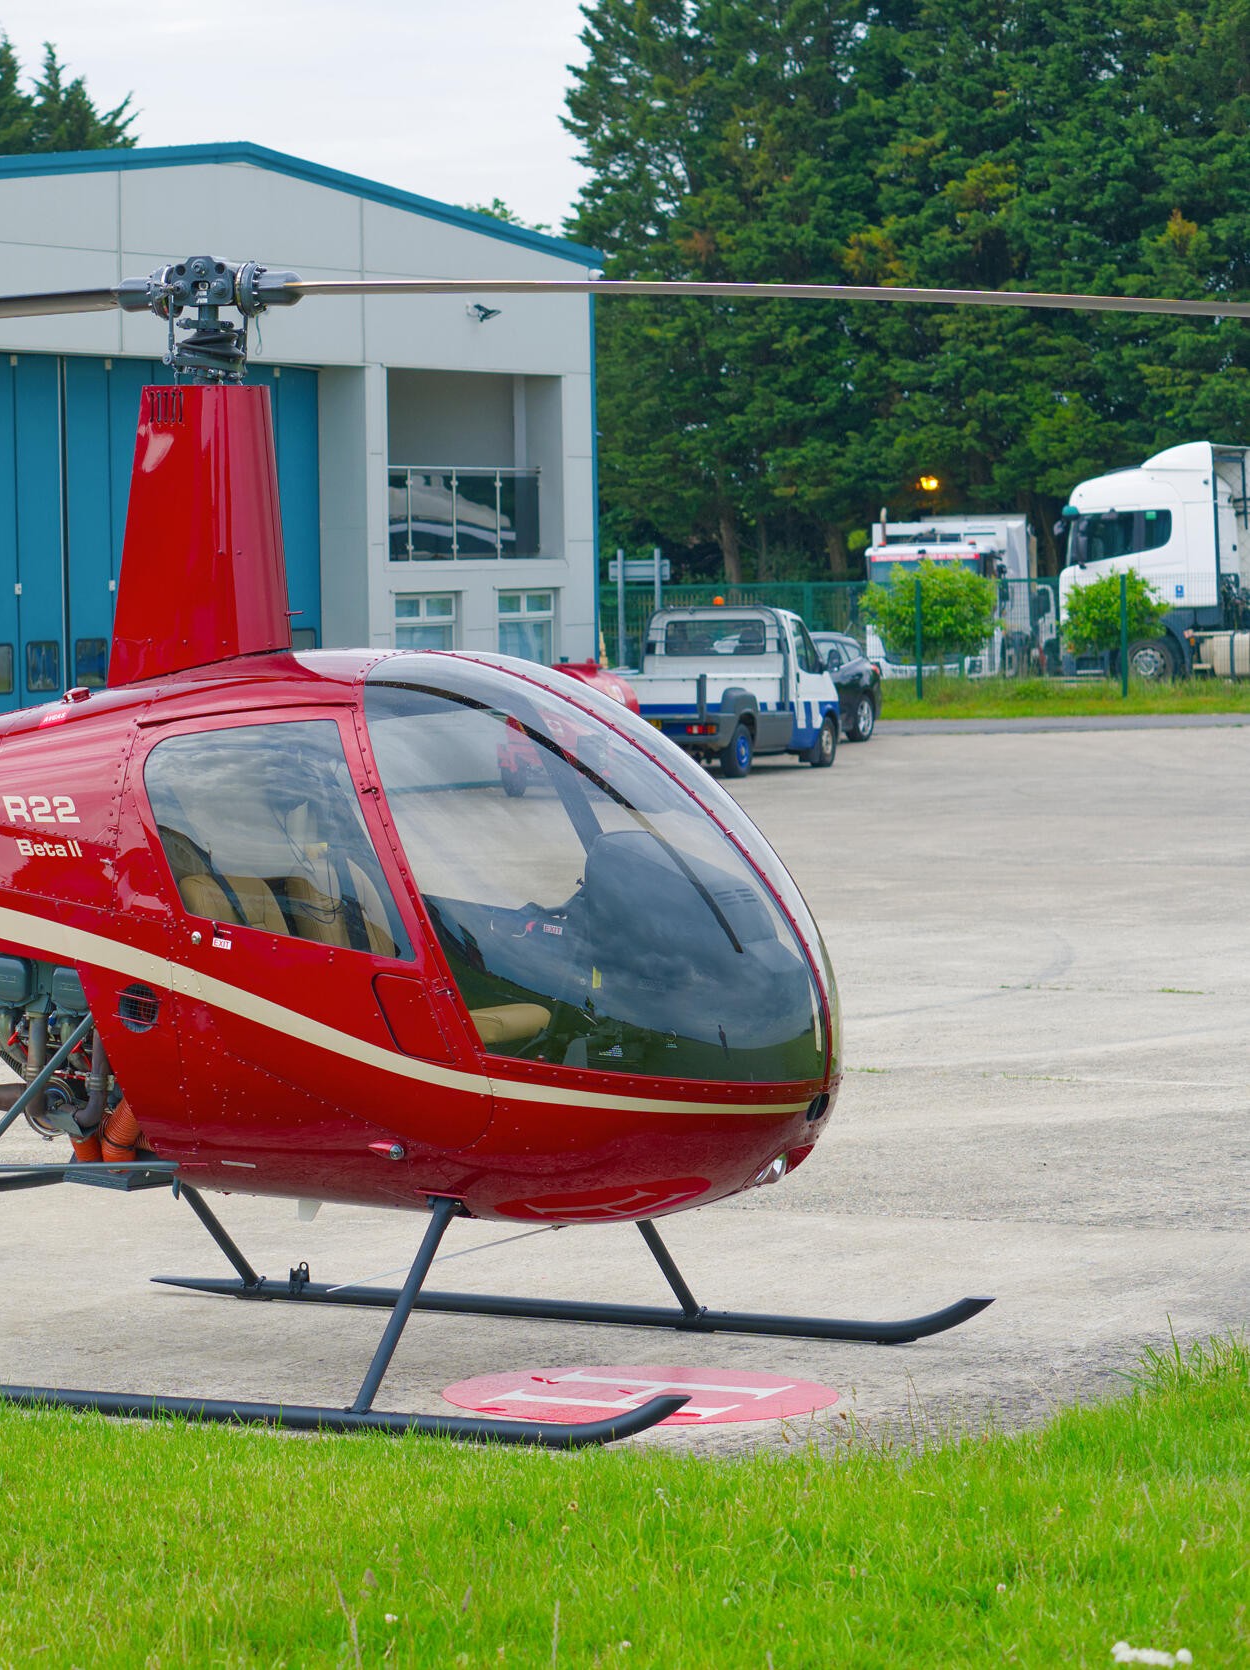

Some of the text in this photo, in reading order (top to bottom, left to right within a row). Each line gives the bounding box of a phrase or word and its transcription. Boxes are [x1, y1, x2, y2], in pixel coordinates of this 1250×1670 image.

[2, 795, 81, 823] R22
[15, 838, 68, 857] Beta
[544, 925, 562, 935] EXIT
[214, 939, 231, 949] EXIT
